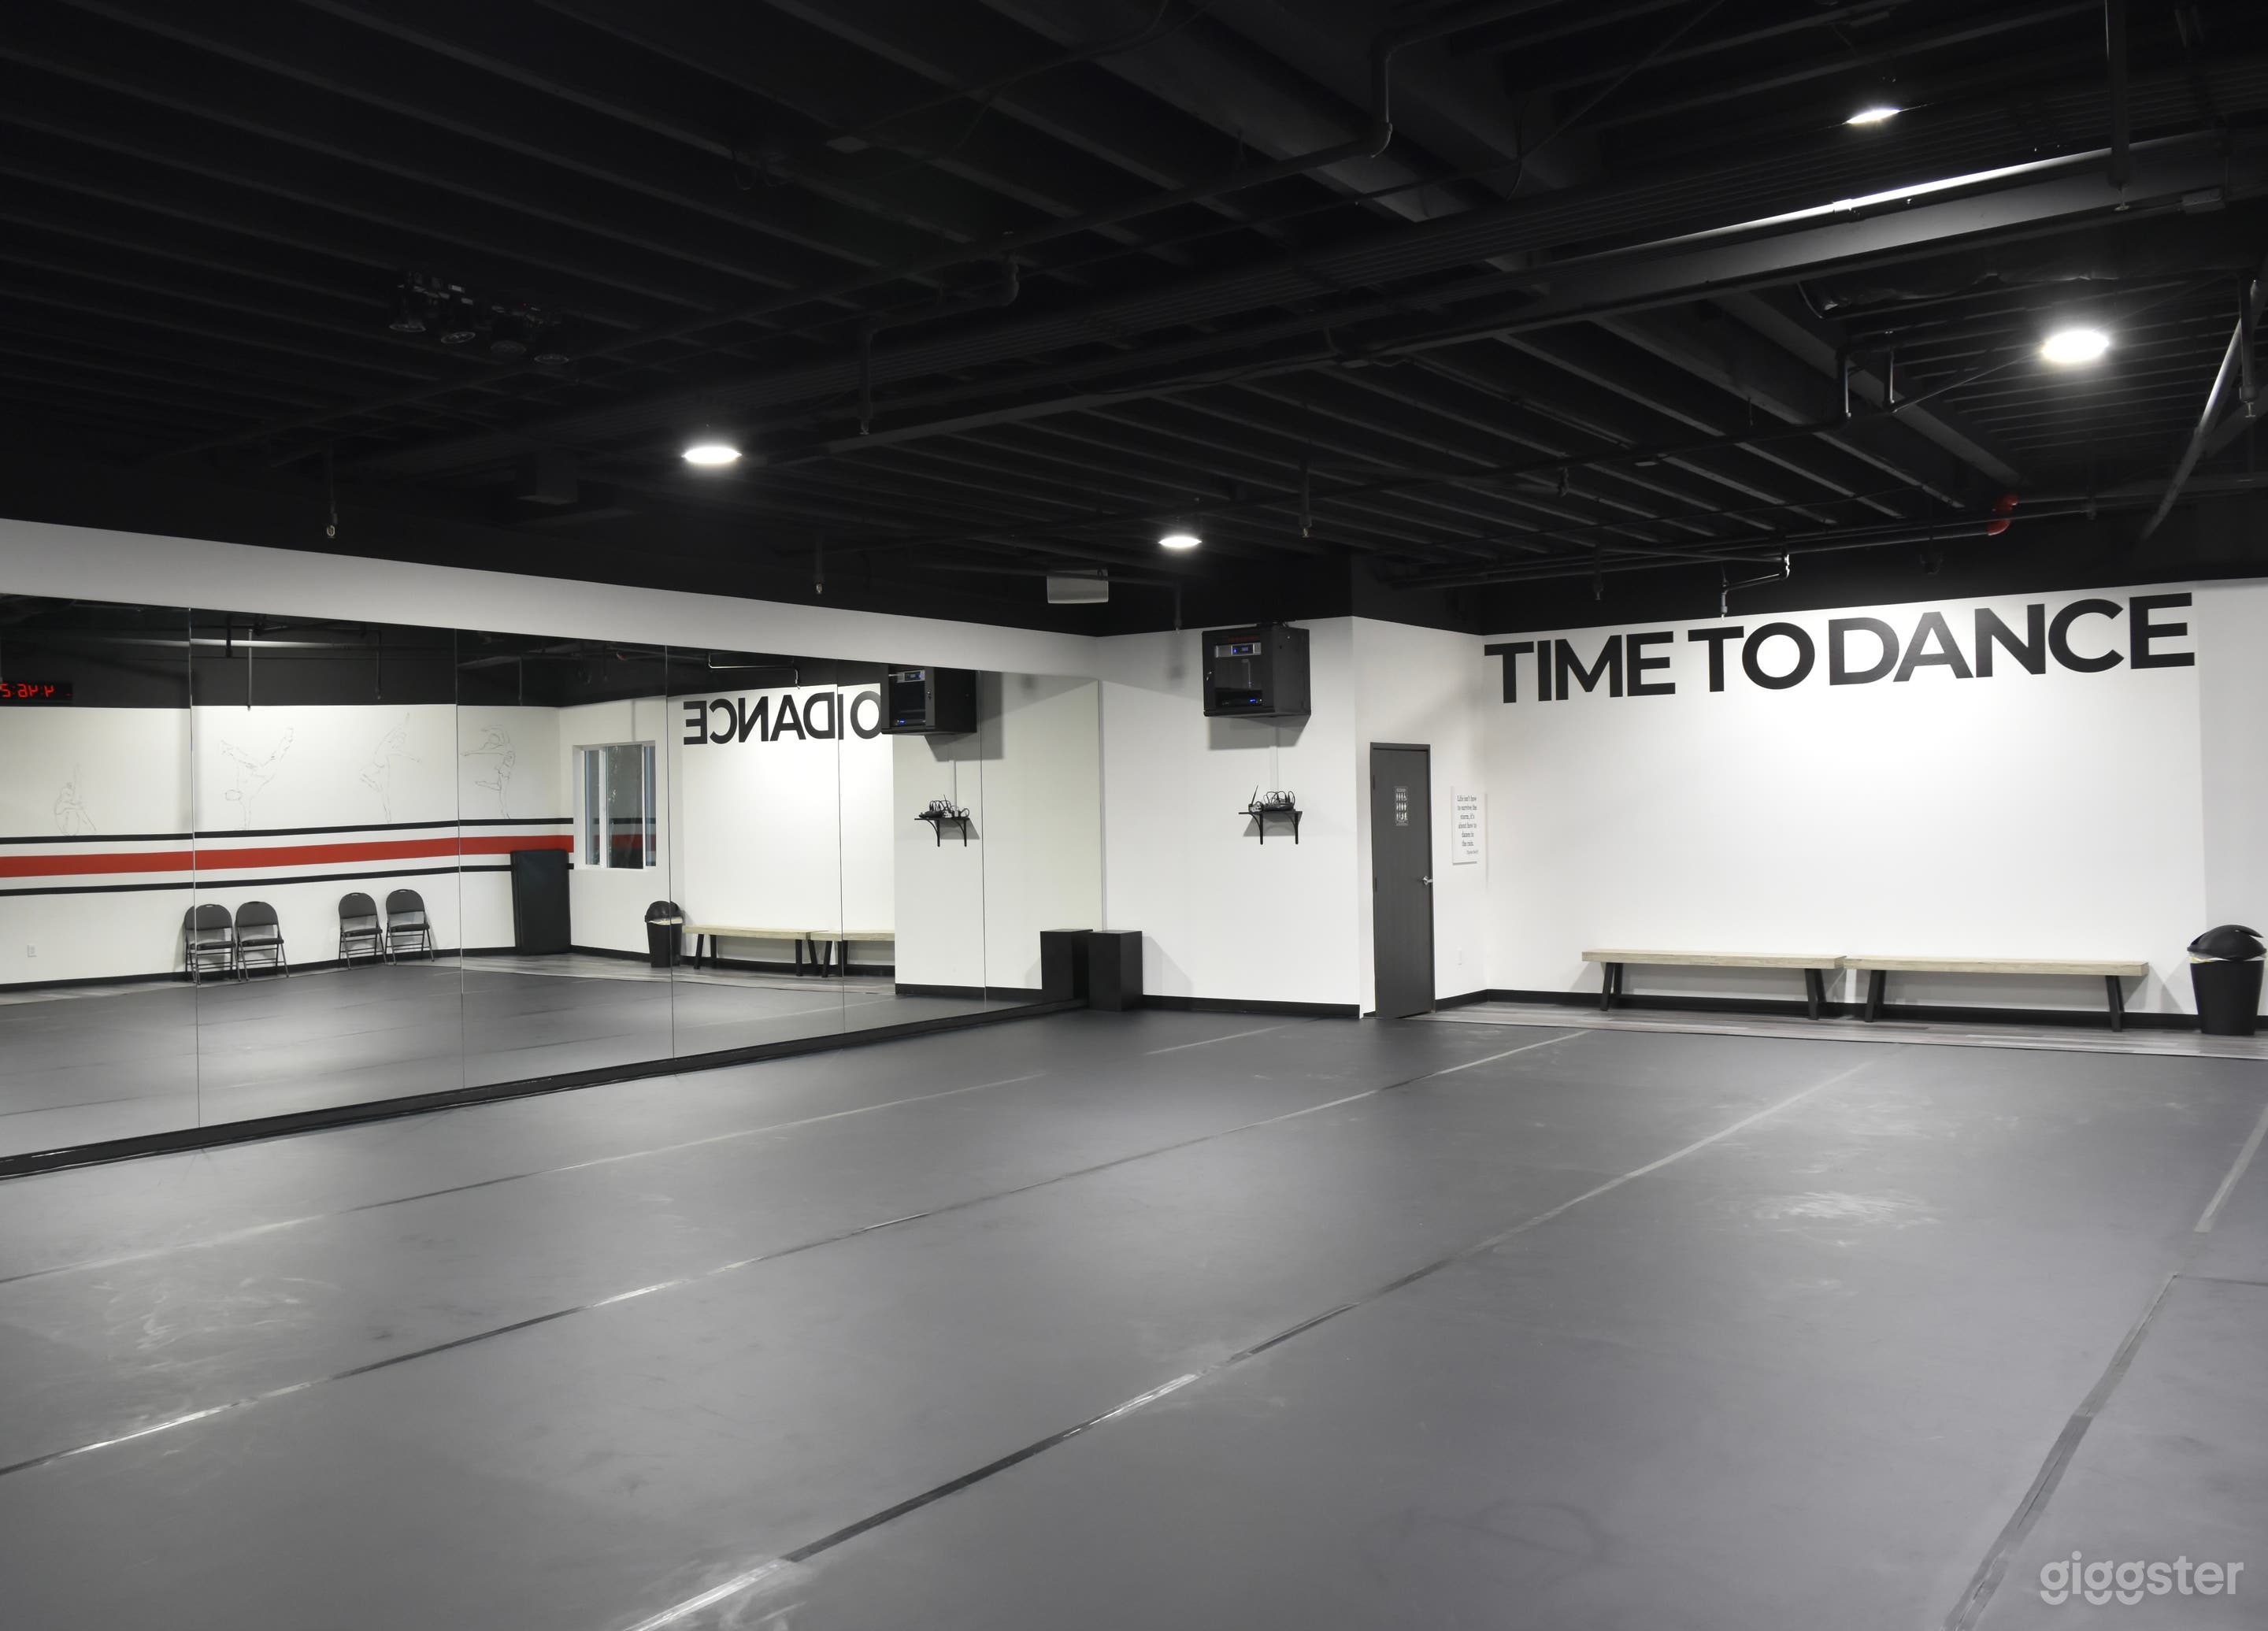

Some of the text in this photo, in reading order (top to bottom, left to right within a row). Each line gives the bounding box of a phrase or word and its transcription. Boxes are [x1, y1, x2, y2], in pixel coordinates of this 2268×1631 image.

[1484, 592, 2196, 704] TIME TO DANCE
